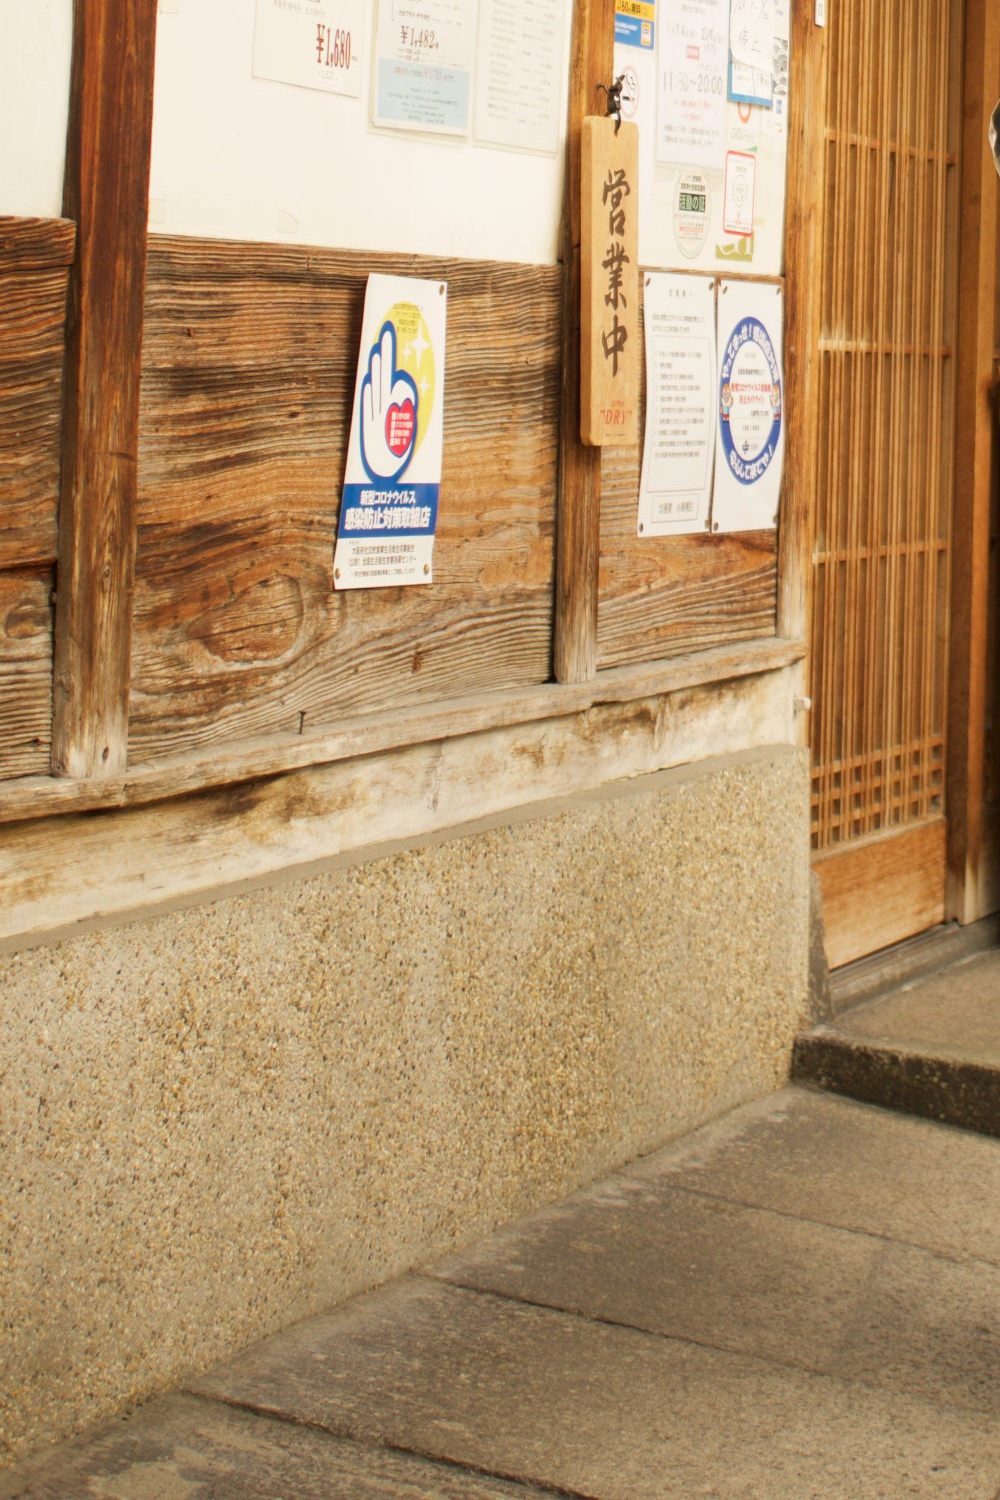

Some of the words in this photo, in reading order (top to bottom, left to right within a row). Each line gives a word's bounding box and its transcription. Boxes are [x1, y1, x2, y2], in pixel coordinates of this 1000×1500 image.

[316, 23, 351, 71] ¥1,680
[400, 25, 436, 50] ¥1,482
[601, 169, 631, 378] 営業中
[360, 490, 417, 506] 新型コロナウイルス
[344, 506, 432, 530] 感染防止対策取組店
